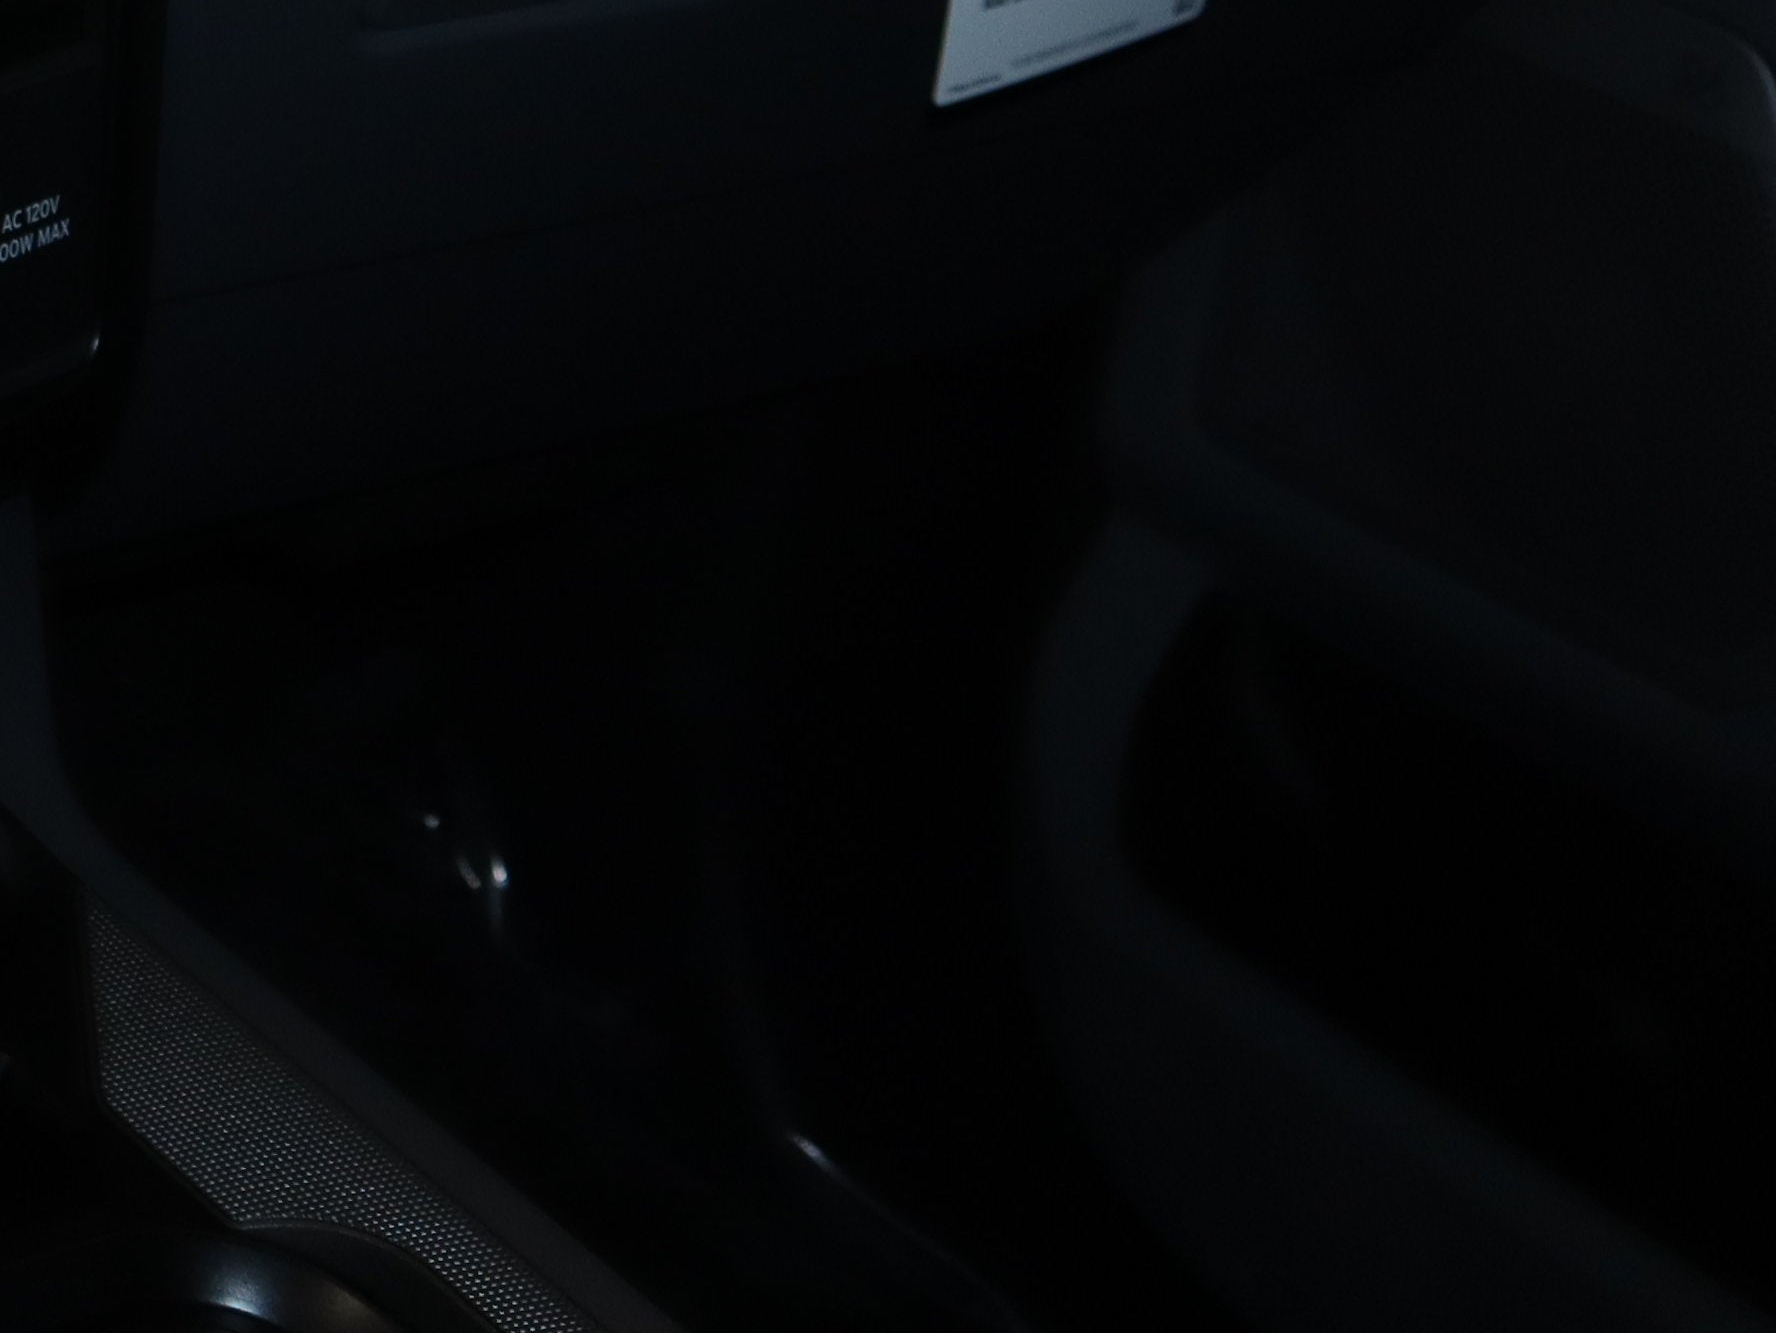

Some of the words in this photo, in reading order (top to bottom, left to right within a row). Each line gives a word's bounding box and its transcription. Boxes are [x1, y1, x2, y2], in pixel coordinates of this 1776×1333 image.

[1, 210, 23, 234] AC
[25, 195, 60, 225] 120V
[37, 218, 70, 248] MAX
